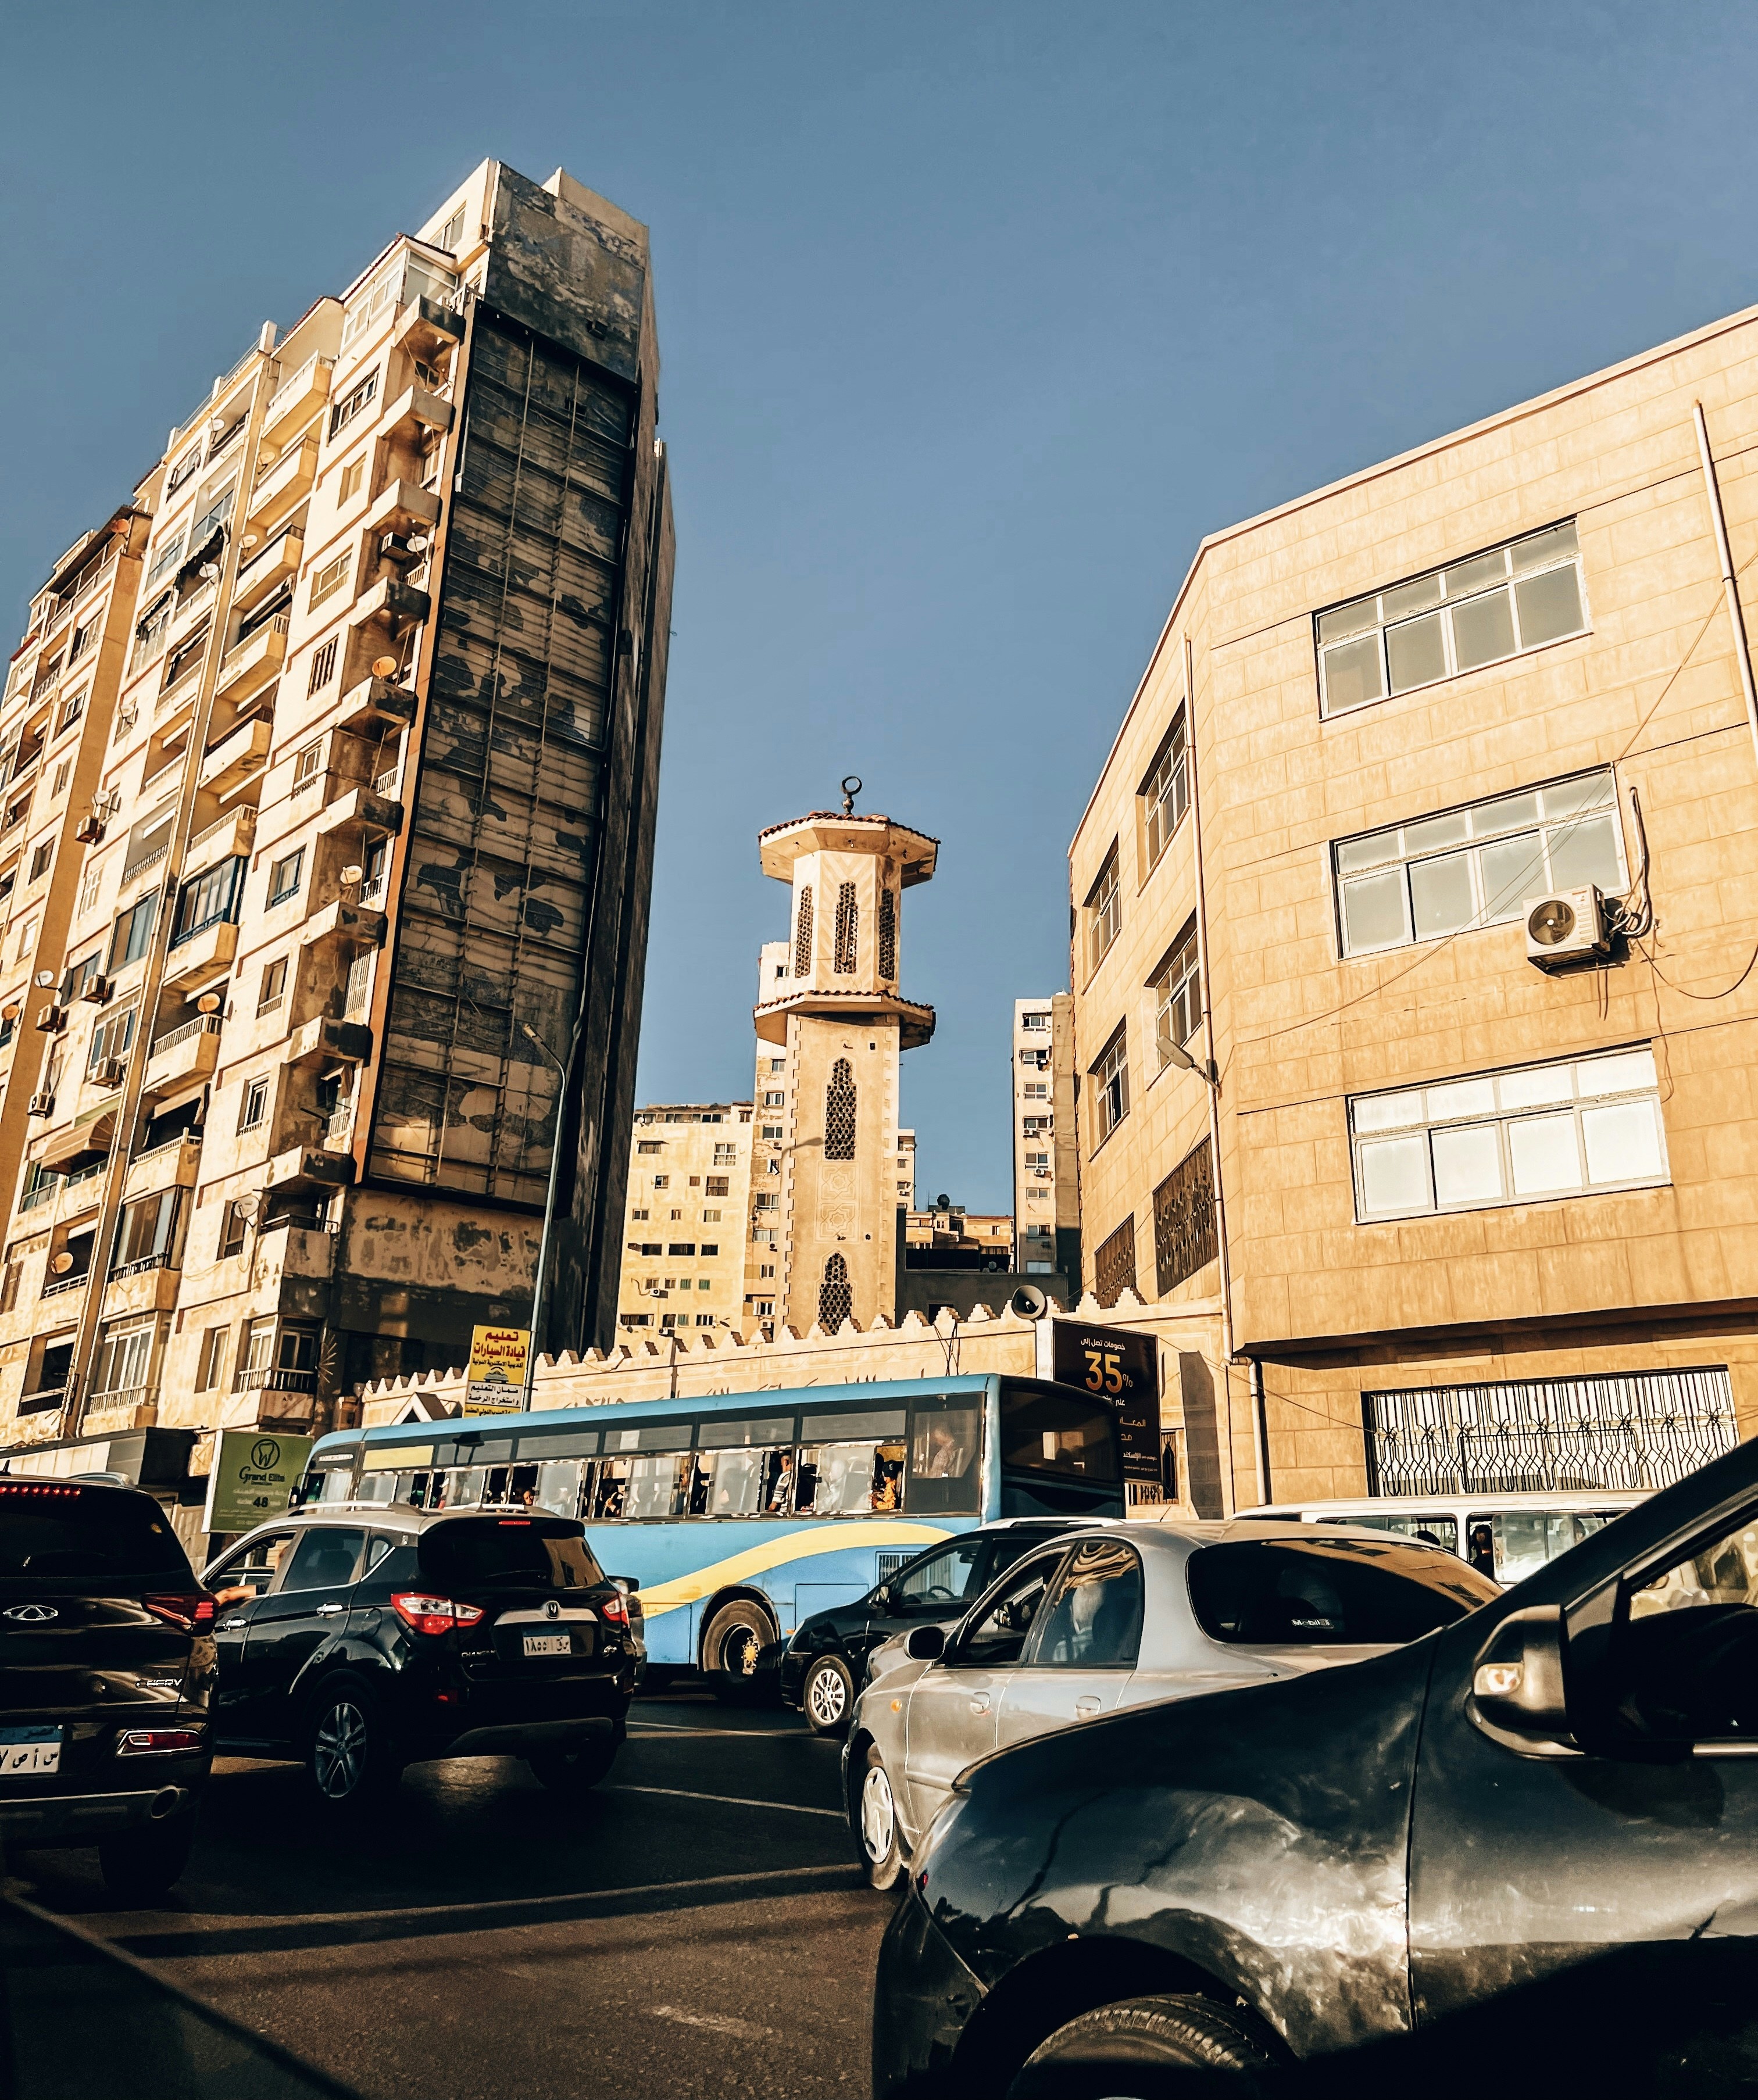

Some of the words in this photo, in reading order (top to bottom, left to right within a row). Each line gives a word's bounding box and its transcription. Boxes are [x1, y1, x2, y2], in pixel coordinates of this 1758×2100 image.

[485, 1331, 519, 1343] تعليم
[1091, 1339, 1103, 1347] تصل
[1103, 1341, 1126, 1350] خصومات
[473, 1342, 505, 1358] السيارات
[506, 1346, 526, 1361] قيادة
[470, 1385, 496, 1393] التعليم
[468, 1393, 491, 1403] الرخصة
[239, 1466, 267, 1484] Grand
[252, 1496, 269, 1507] 48
